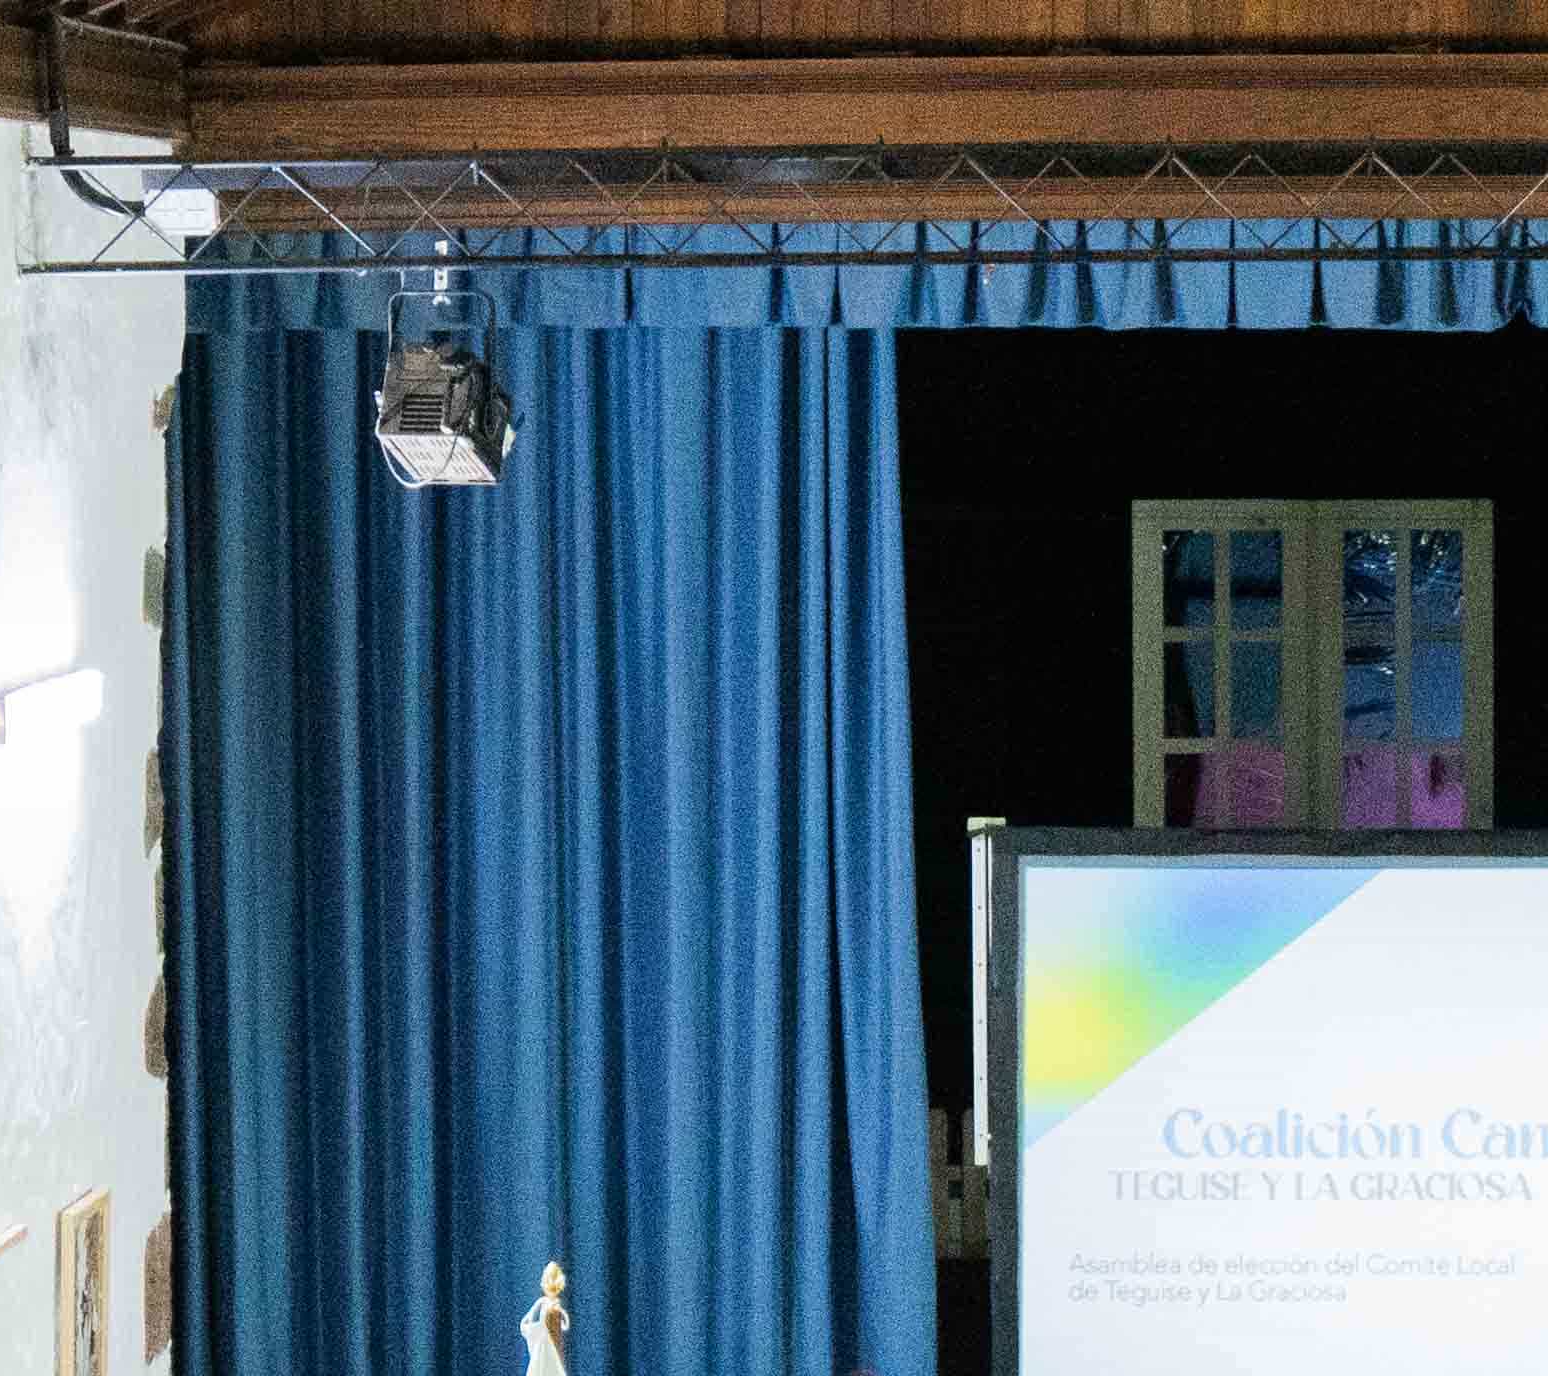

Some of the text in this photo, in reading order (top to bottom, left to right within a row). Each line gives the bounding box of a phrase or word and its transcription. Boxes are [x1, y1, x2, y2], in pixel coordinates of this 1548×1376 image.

[1161, 1106, 1423, 1161] Coalición
[1109, 1170, 1533, 1202] TEGUISE Y LA GRACIOSA
[1068, 1250, 1182, 1276] Asamblea
[1188, 1252, 1219, 1276] de
[1325, 1252, 1360, 1276] del
[1456, 1252, 1517, 1276] Local
[1068, 1279, 1348, 1310] de Teguise y La Graciosa
